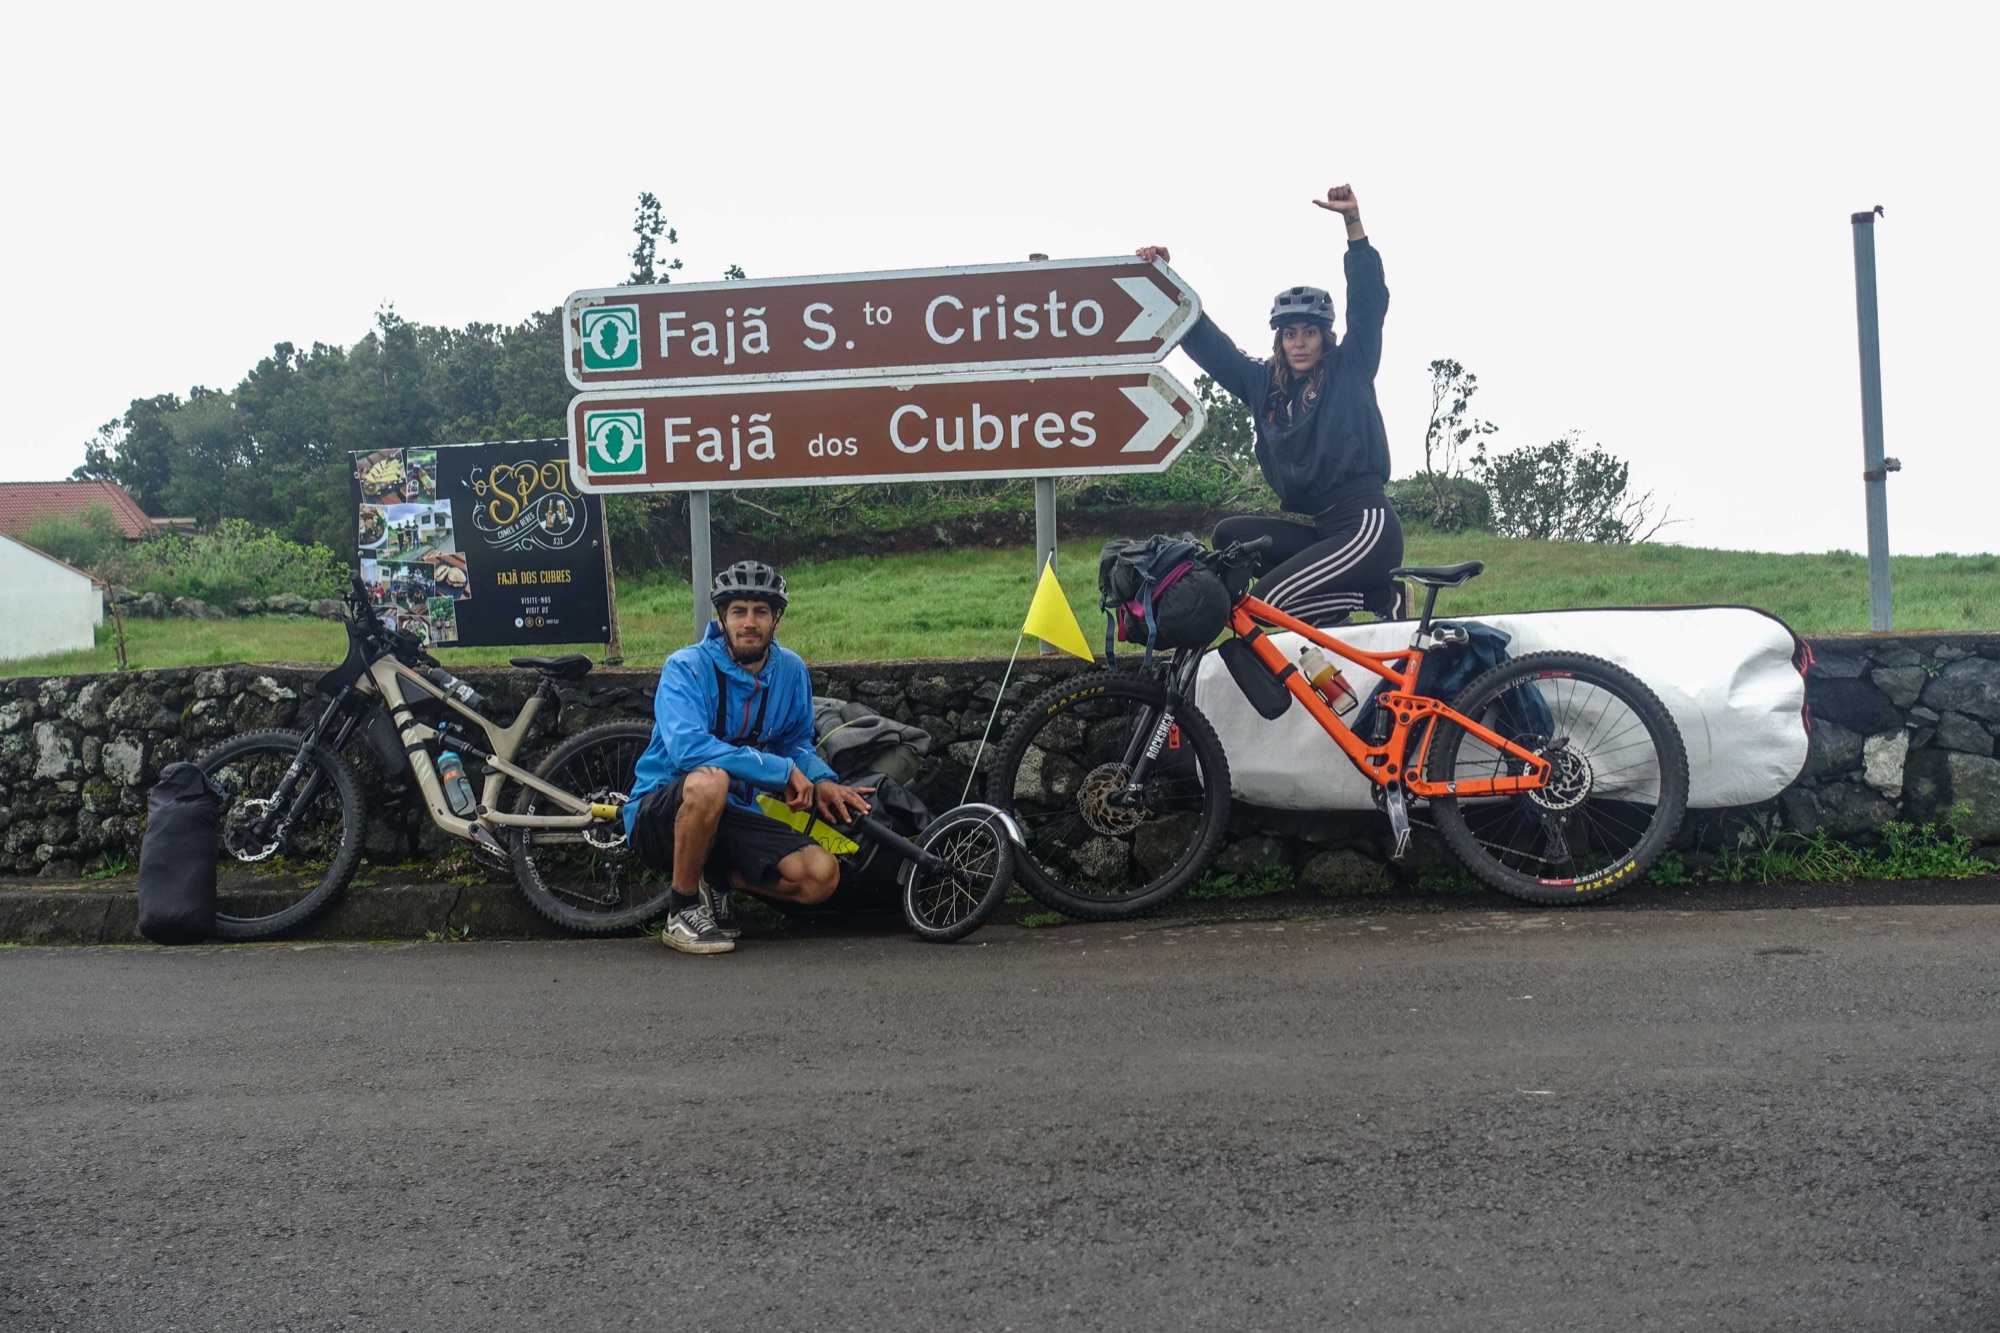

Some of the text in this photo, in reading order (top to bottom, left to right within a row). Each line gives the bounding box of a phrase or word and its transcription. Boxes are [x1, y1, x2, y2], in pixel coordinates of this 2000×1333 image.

[659, 306, 770, 365] Fajã
[925, 290, 1104, 345] Cristo
[664, 403, 1098, 471] Fajã dos Cubres
[497, 525, 516, 540] COMES
[497, 568, 572, 586] FAJÃ DOS CUBRES
[520, 595, 552, 605] VISITE-NOS
[525, 606, 549, 615] VISIT US
[1046, 685, 1106, 716] MAXXIS
[1575, 859, 1637, 892] MAXXIS
